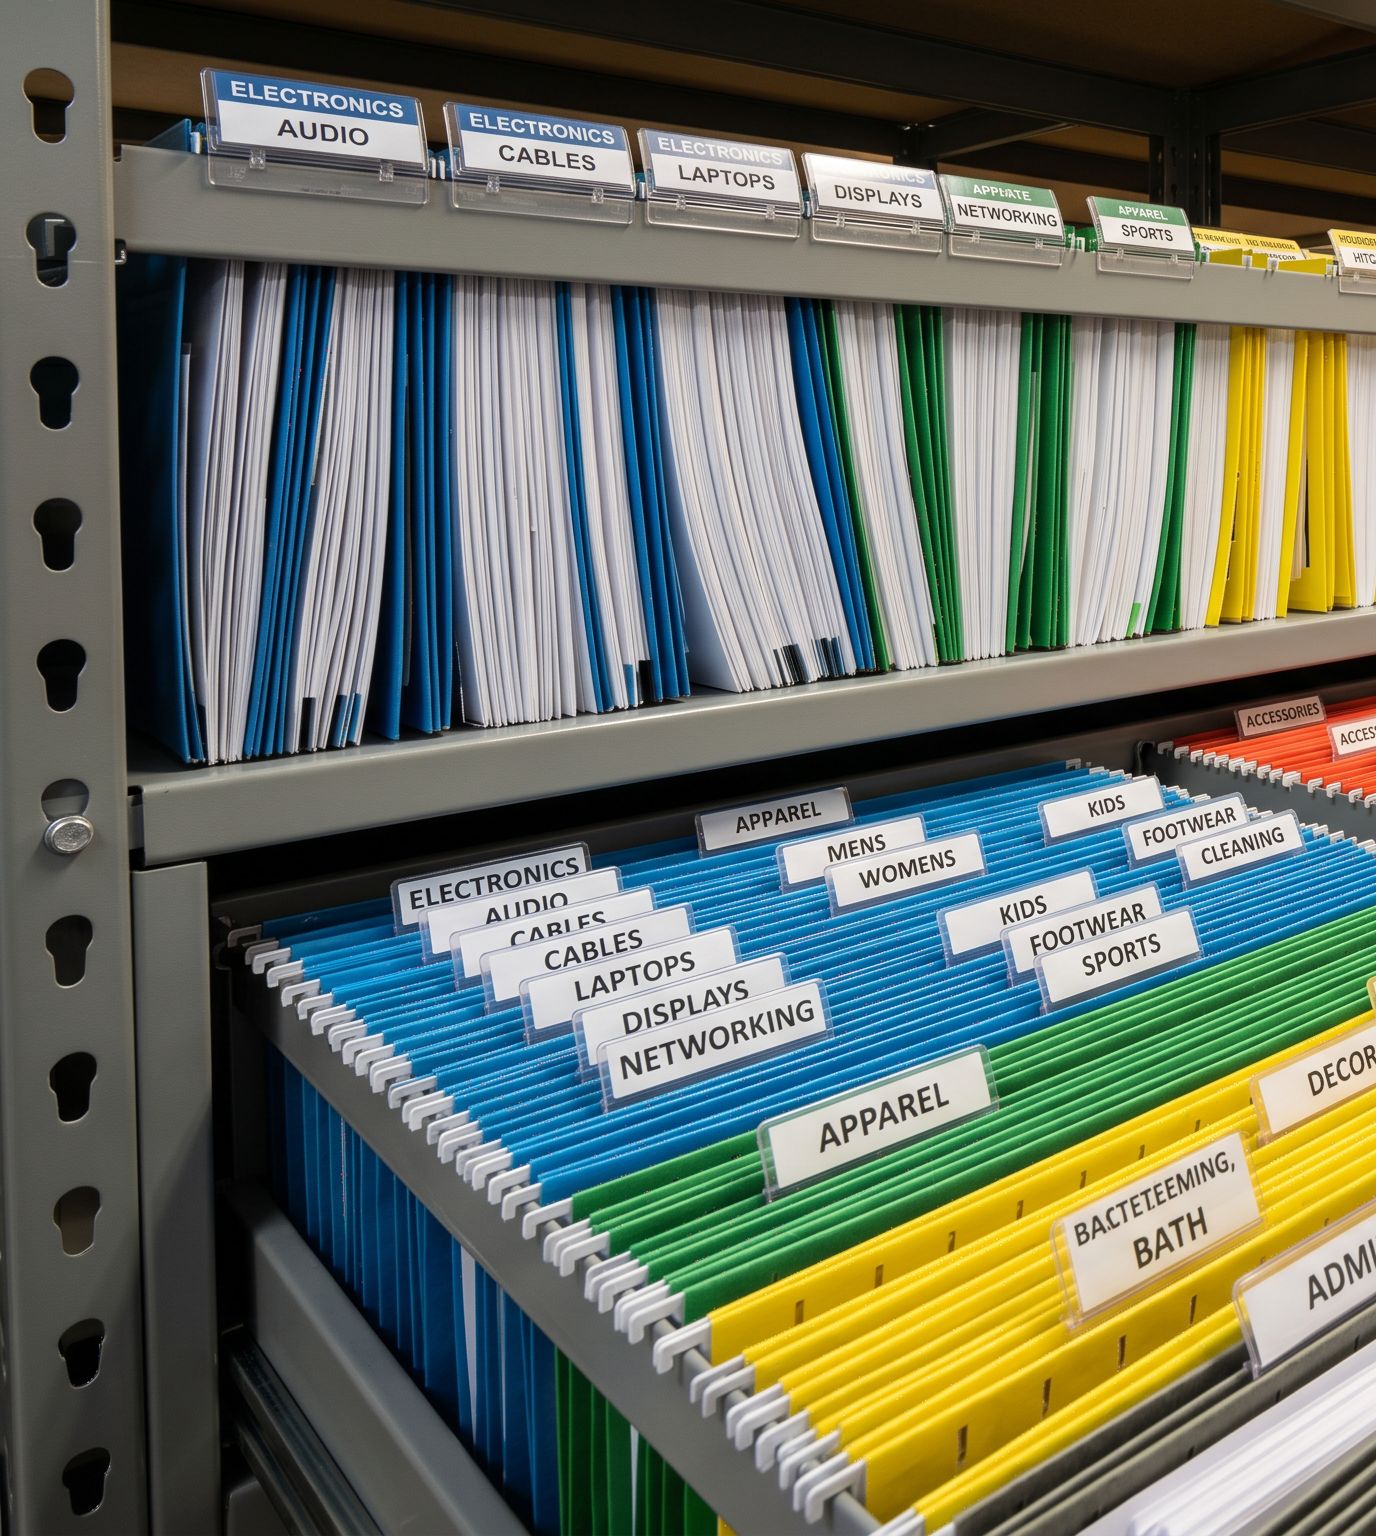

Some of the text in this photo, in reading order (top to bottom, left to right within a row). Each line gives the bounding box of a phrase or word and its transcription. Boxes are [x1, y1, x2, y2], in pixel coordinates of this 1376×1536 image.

[231, 80, 404, 118] ELECTRONICS
[277, 119, 369, 146] AUDIO
[470, 113, 614, 144] ELECTRONICS
[499, 145, 596, 171] CABLES
[658, 137, 782, 166] ELECTRONICS
[678, 164, 775, 190] LAPTOPS
[834, 185, 922, 208] DISPLAYS
[958, 203, 1057, 227] NETWORKING
[1122, 224, 1173, 242] SPORTS
[1246, 702, 1320, 728] ACCESSORIES
[735, 801, 822, 834] APPAREL
[1088, 794, 1126, 818] KIDS
[1142, 806, 1237, 847] FOOTWEAR
[827, 834, 886, 864] MENS
[1200, 826, 1285, 866] CLEANING
[410, 857, 579, 910] ELECTRONICS
[858, 850, 956, 889] WOMENS
[486, 892, 568, 924] AUDIO
[999, 895, 1048, 926] KIDS
[1029, 902, 1145, 957] FOOTWEAR
[544, 930, 642, 970] CABLES
[1082, 932, 1161, 977] SPORTS
[574, 951, 695, 1001] LAPTOPS
[622, 980, 750, 1034] DISPLAYS
[620, 999, 815, 1080] NETWORKING
[819, 1083, 949, 1154] APPAREL
[1133, 1206, 1208, 1269] BATH
